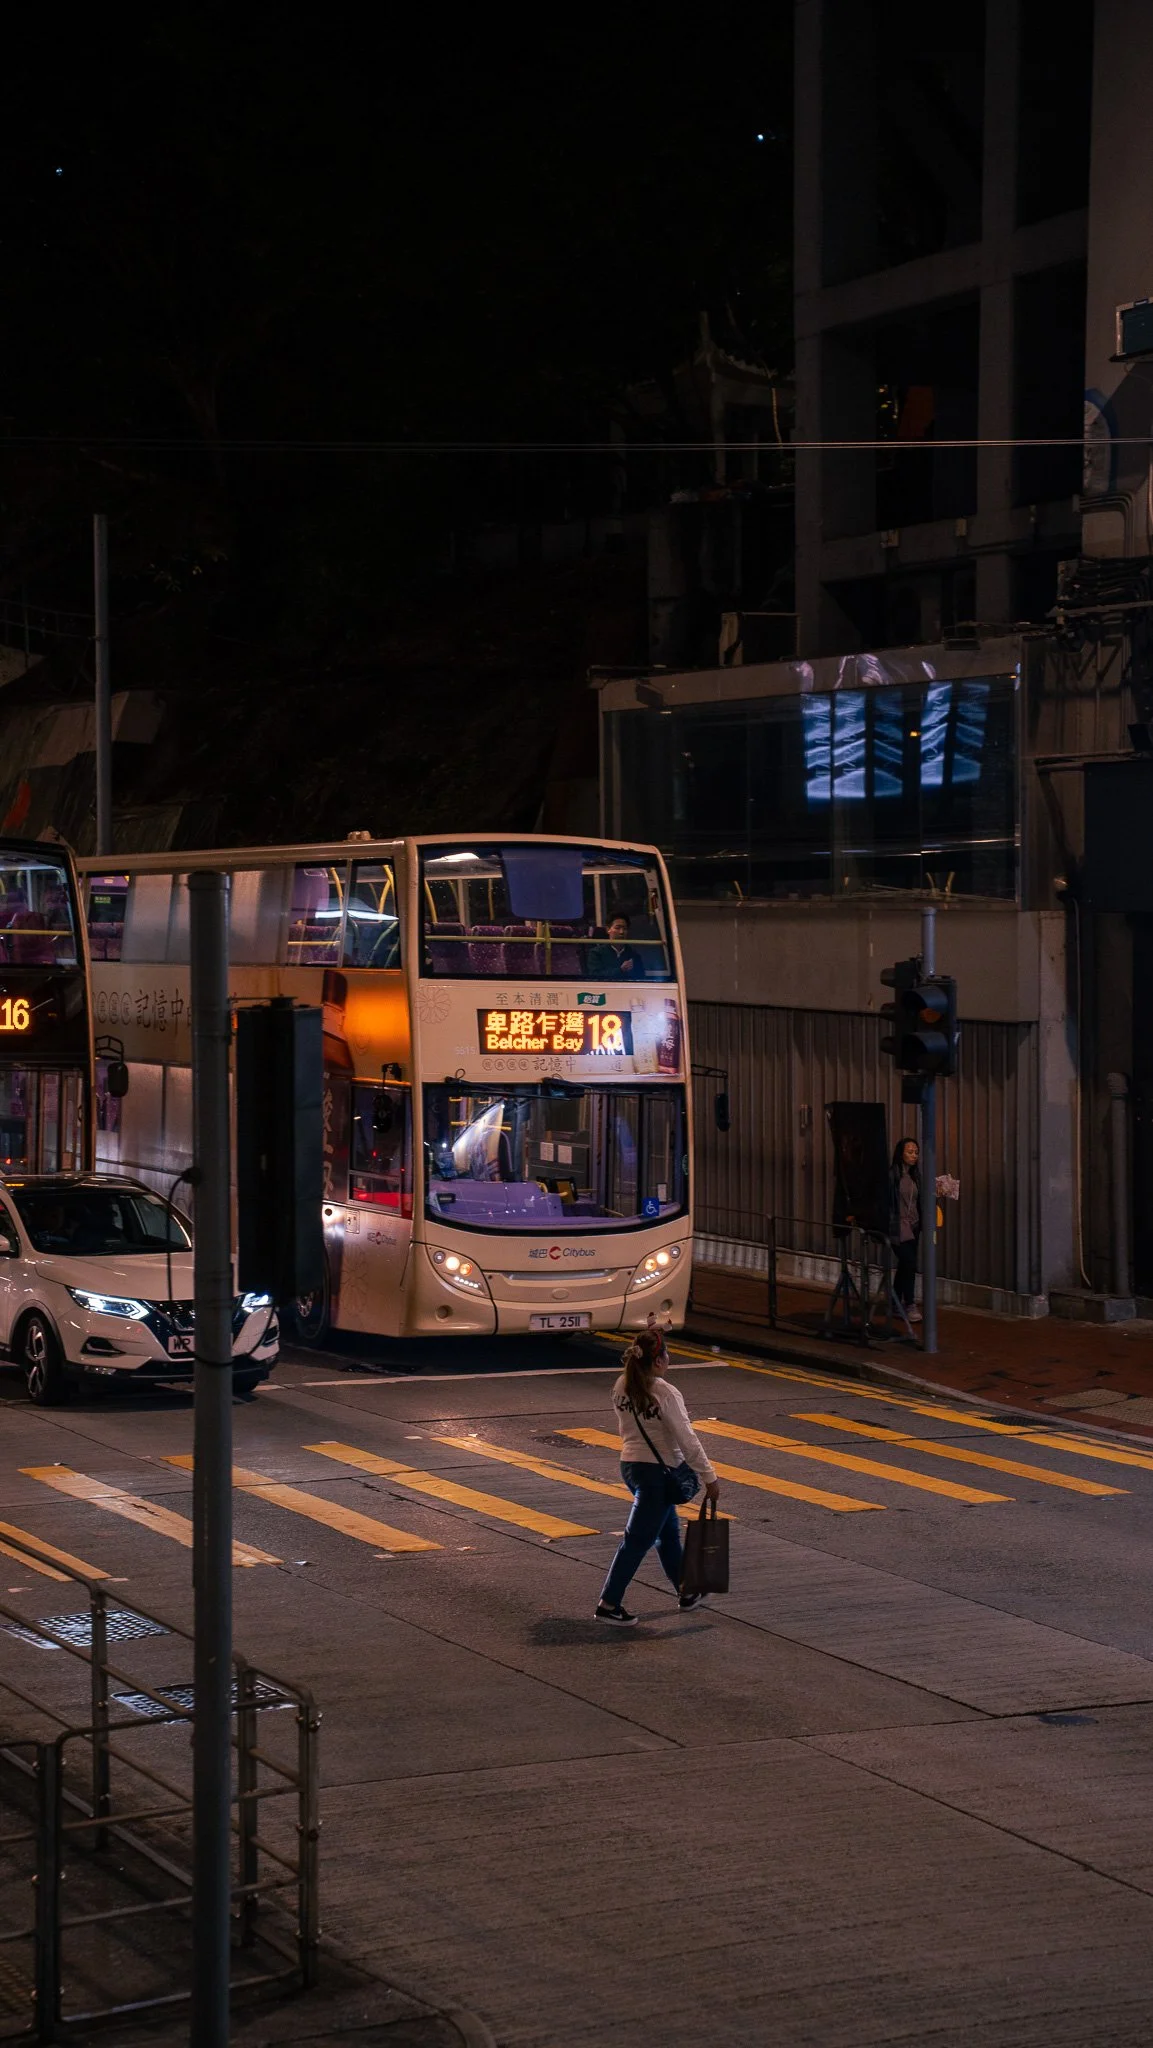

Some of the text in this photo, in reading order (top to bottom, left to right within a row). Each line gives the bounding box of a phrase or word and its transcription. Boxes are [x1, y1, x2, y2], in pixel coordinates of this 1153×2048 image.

[0, 998, 30, 1030] 16
[485, 1011, 584, 1035] 卑路乍灣
[588, 1015, 622, 1050] 18
[487, 1035, 584, 1052] Belcher Bay
[562, 1247, 596, 1257] Citybus
[539, 1316, 581, 1328] TL 2511
